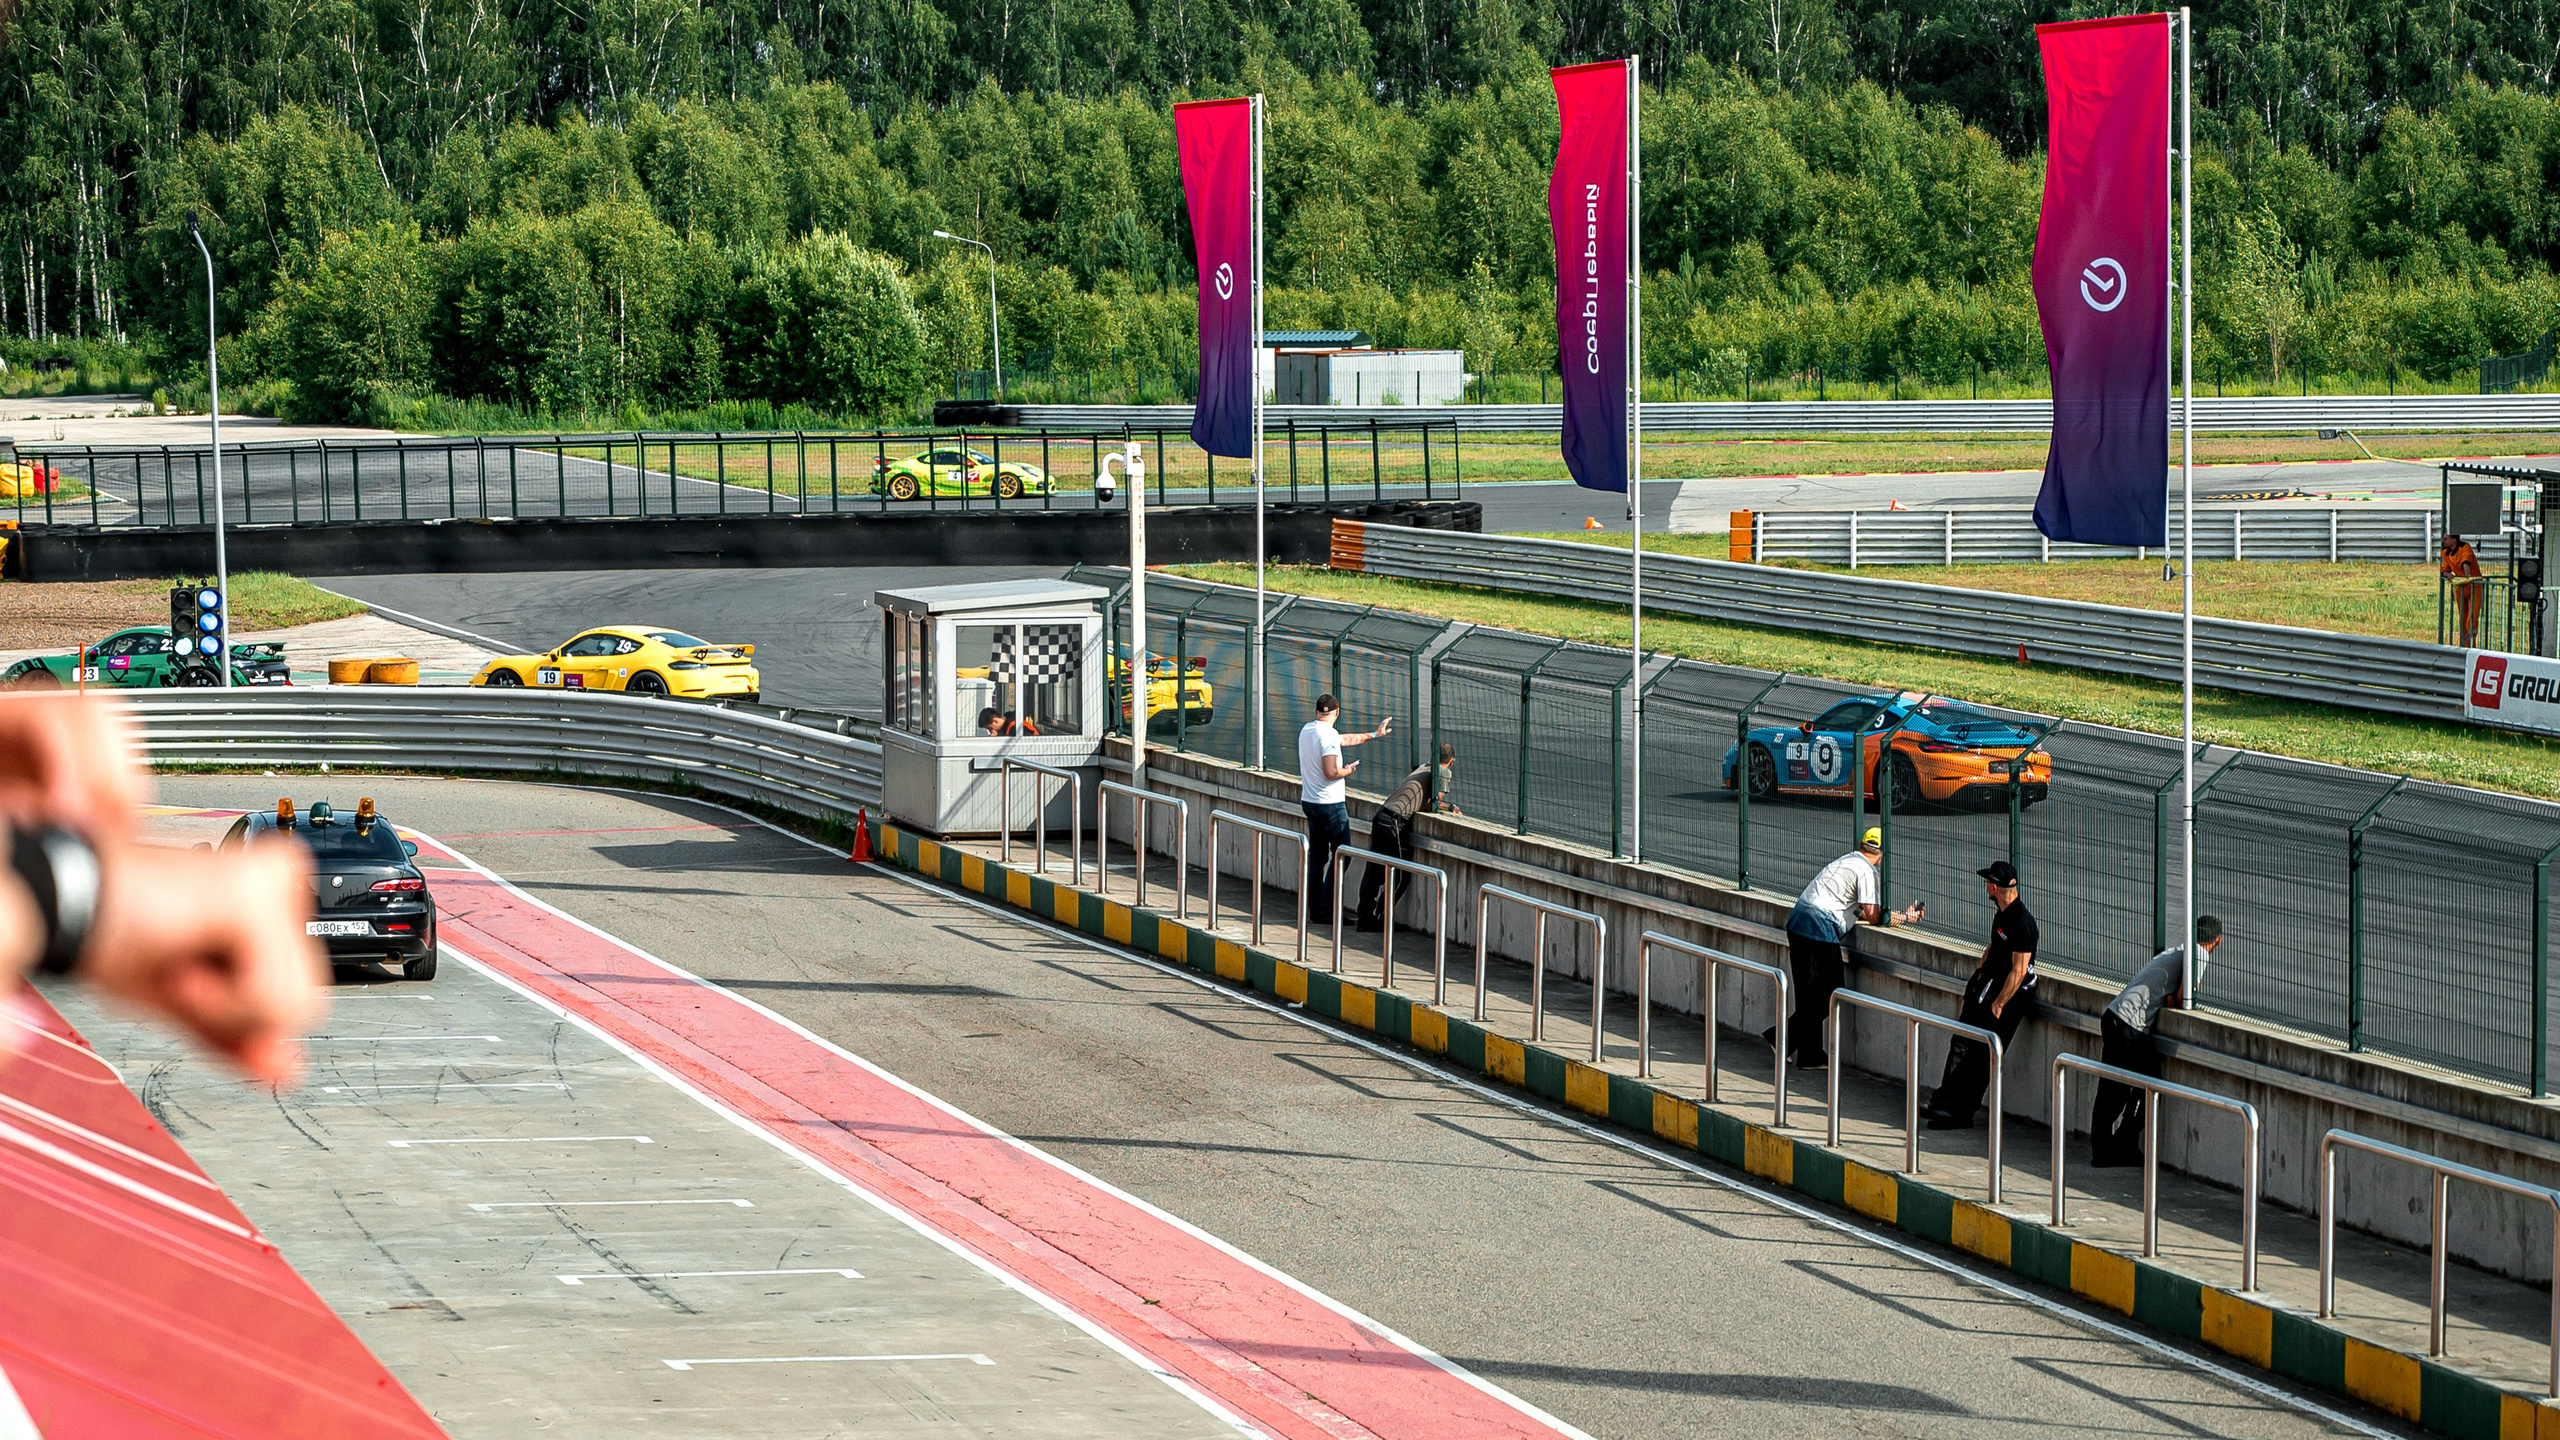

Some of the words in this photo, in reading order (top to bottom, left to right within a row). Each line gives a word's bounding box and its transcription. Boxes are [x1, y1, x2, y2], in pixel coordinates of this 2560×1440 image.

[616, 639, 632, 654] 19
[543, 671, 556, 684] 19
[1795, 744, 1803, 758] 9
[1819, 743, 1834, 776] 9
[351, 921, 366, 930] 152
